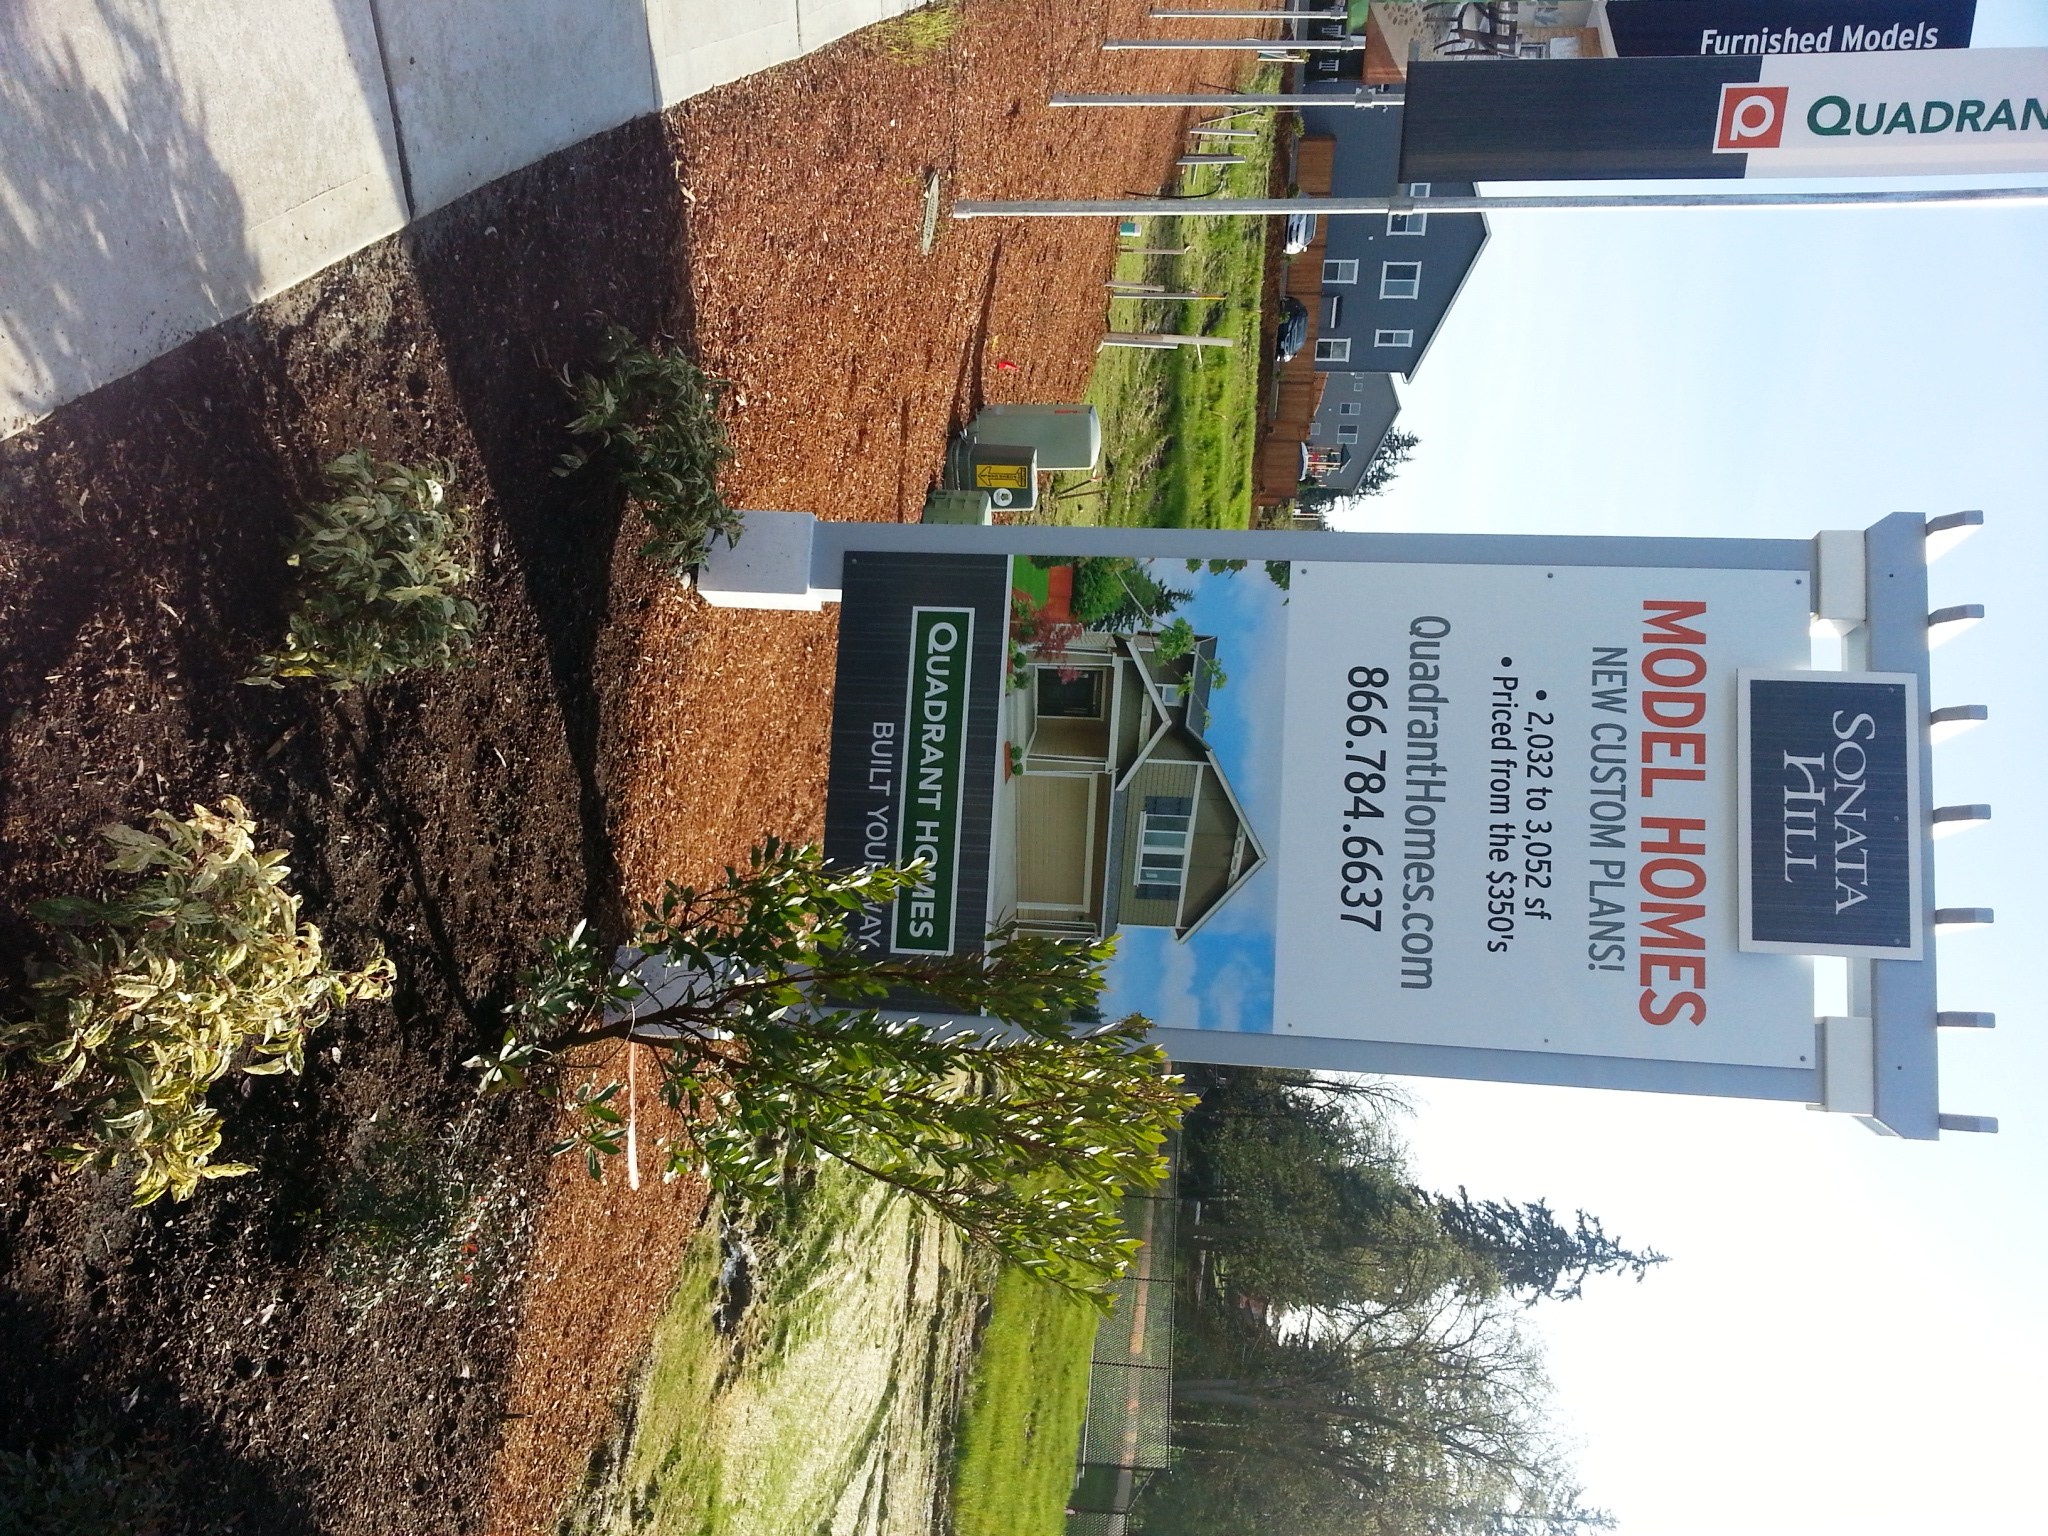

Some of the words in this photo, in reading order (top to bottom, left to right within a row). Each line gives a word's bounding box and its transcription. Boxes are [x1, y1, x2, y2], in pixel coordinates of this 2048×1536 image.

[1700, 25, 1833, 55] Furnished
[1840, 21, 1939, 52] Models
[917, 621, 958, 811] QUADRANT
[1490, 676, 1519, 751] Priced
[1591, 646, 1628, 715] NEW
[1640, 600, 1708, 798] MODEL
[868, 721, 895, 797] BUILT
[1523, 711, 1555, 779] 2,032
[1340, 665, 1390, 932] 866.784.6637
[1400, 615, 1451, 990] QuadrantHomes.com
[1489, 758, 1518, 815] from
[1525, 786, 1553, 811] to
[1589, 722, 1628, 849] CUSTOM
[1783, 749, 1826, 883] HILL
[1832, 710, 1876, 915] SONATA
[1488, 822, 1517, 863] the
[1521, 819, 1553, 889] 3,052
[1485, 870, 1518, 953] $350's
[1524, 896, 1552, 921] sf
[1587, 859, 1626, 972] PLANS!
[1638, 816, 1707, 1027] HOMES
